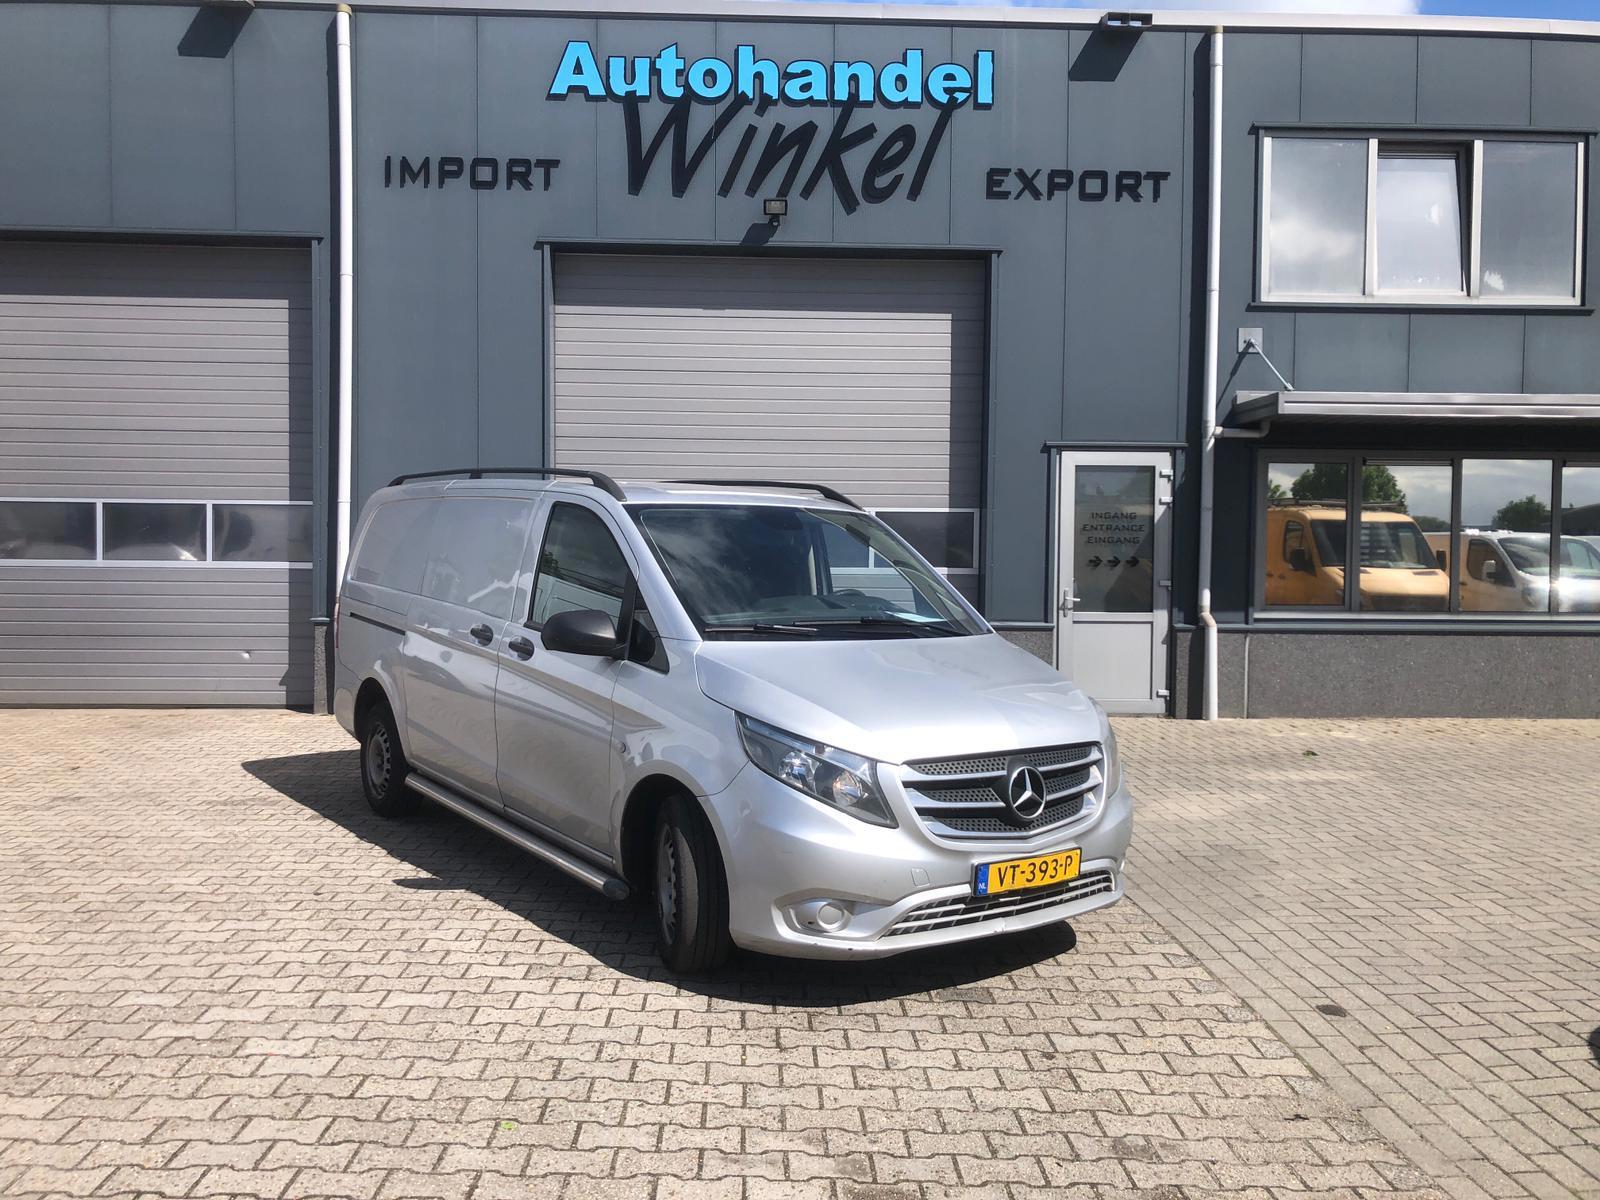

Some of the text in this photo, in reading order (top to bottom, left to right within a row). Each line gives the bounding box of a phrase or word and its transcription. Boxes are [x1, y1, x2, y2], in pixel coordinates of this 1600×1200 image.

[547, 40, 996, 109] Autohandel
[622, 92, 958, 215] Winkel
[384, 155, 561, 192] IMPORT
[985, 167, 1171, 203] EXPORT
[1082, 523, 1145, 532] ENTRANCE
[1090, 512, 1137, 520] INGANG
[1087, 536, 1140, 544] EINGANG
[978, 882, 987, 890] NL
[997, 854, 1073, 888] VT-393-P
